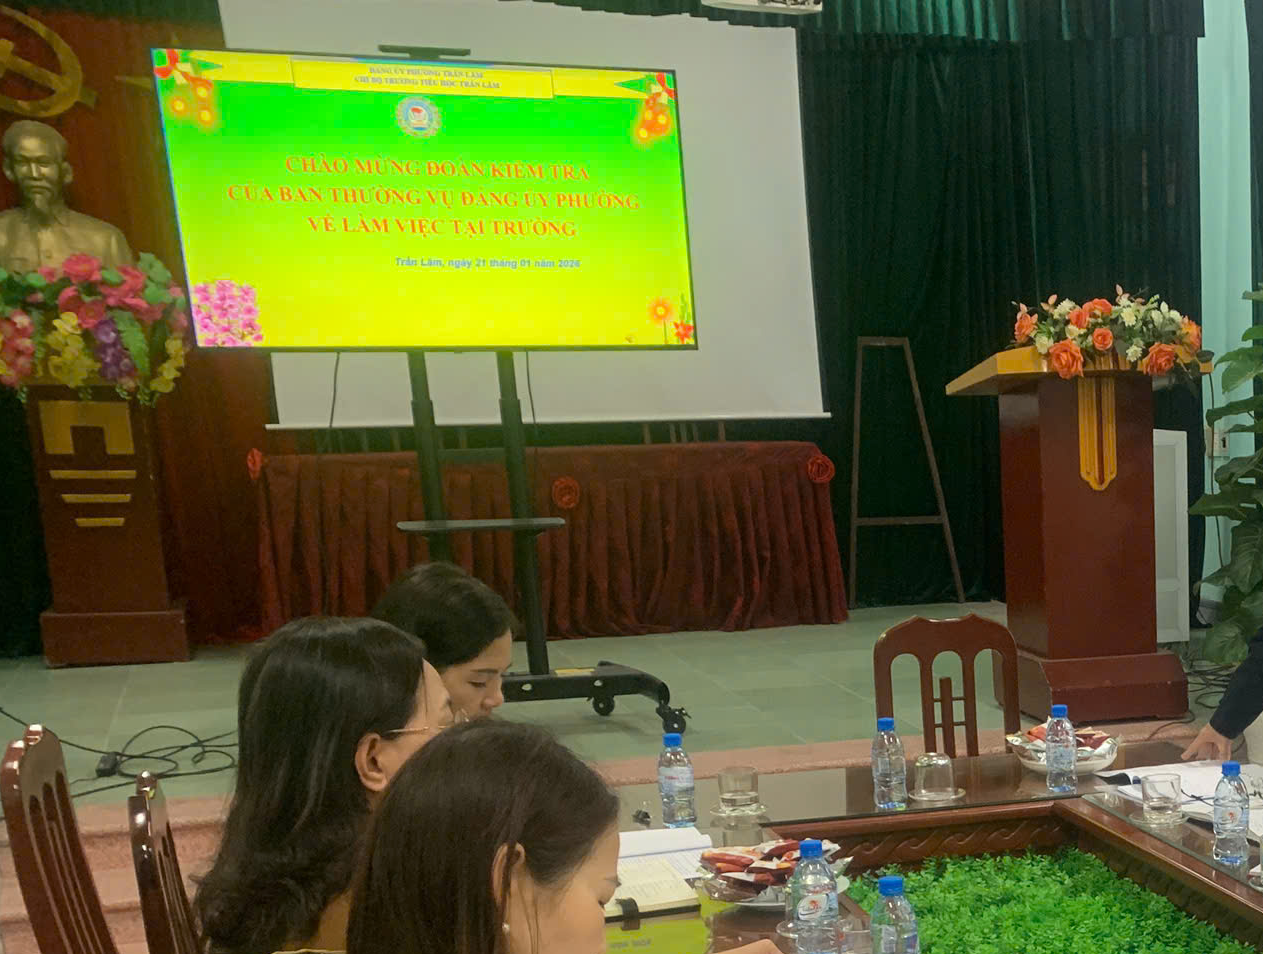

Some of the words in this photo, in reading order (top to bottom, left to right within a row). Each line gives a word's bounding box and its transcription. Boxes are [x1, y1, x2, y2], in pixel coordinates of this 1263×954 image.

[285, 153, 349, 174] CHÀO
[355, 154, 421, 176] MỪNG
[427, 156, 485, 177] ĐOÀN
[549, 164, 591, 181] TRA
[227, 180, 274, 201] CỦA
[279, 186, 323, 202] BAN
[328, 184, 421, 205] THƯỜNG
[425, 190, 454, 210] VỤ
[461, 186, 519, 207] ĐẢNG
[556, 188, 640, 210] PHƯỜNG
[341, 213, 390, 233] LÀM
[394, 217, 444, 238] VIỆC
[450, 218, 485, 239] TẠI
[490, 217, 576, 237] TRƯỜNG
[475, 258, 486, 267] 21
[489, 258, 518, 270] tháng
[519, 259, 531, 268] 01
